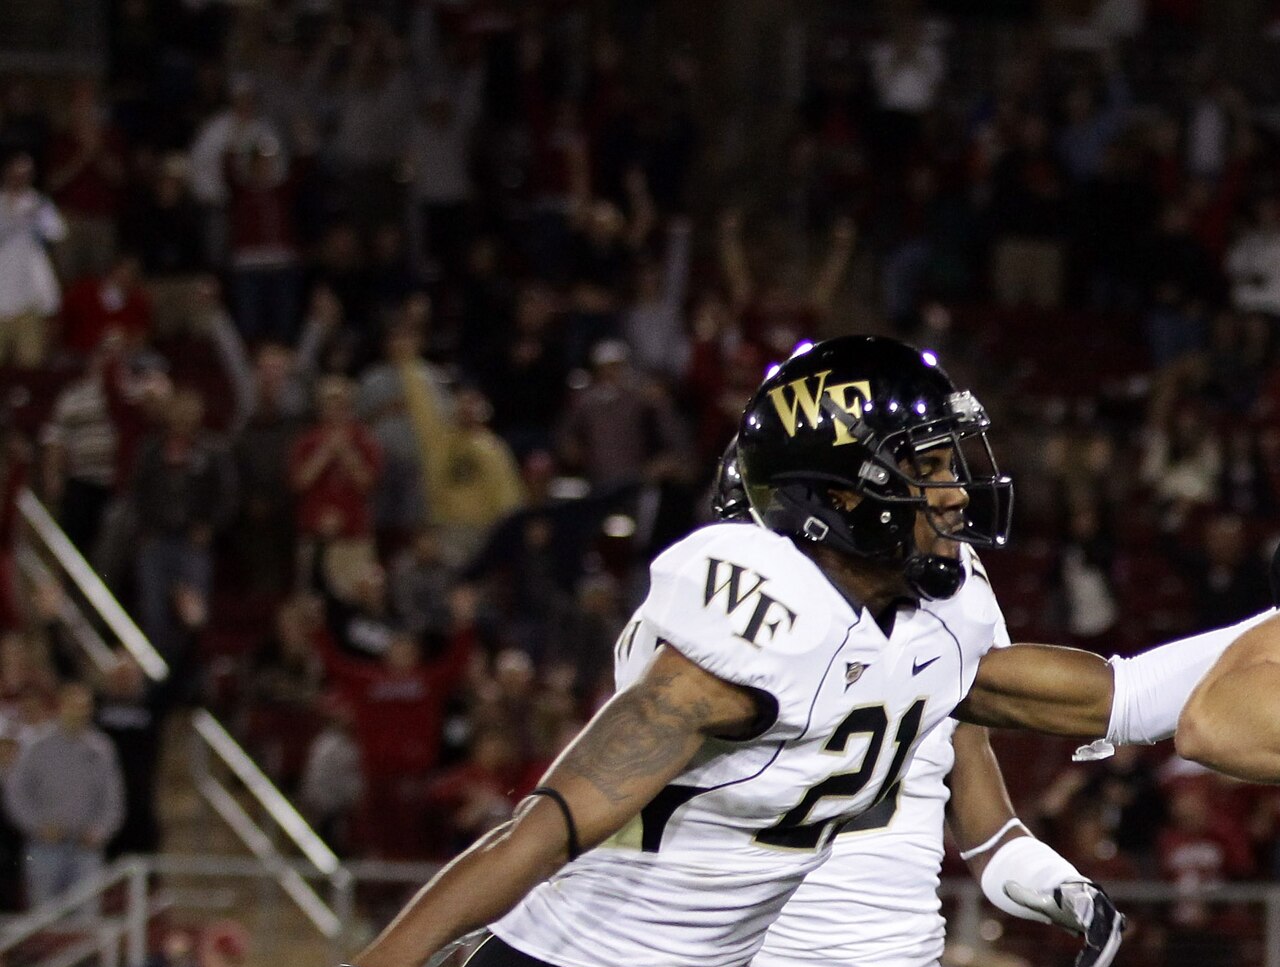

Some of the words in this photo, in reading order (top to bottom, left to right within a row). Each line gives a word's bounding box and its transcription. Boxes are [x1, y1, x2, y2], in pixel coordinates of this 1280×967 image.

[769, 370, 871, 447] WF
[702, 557, 798, 650] WF
[750, 695, 930, 853] 21
